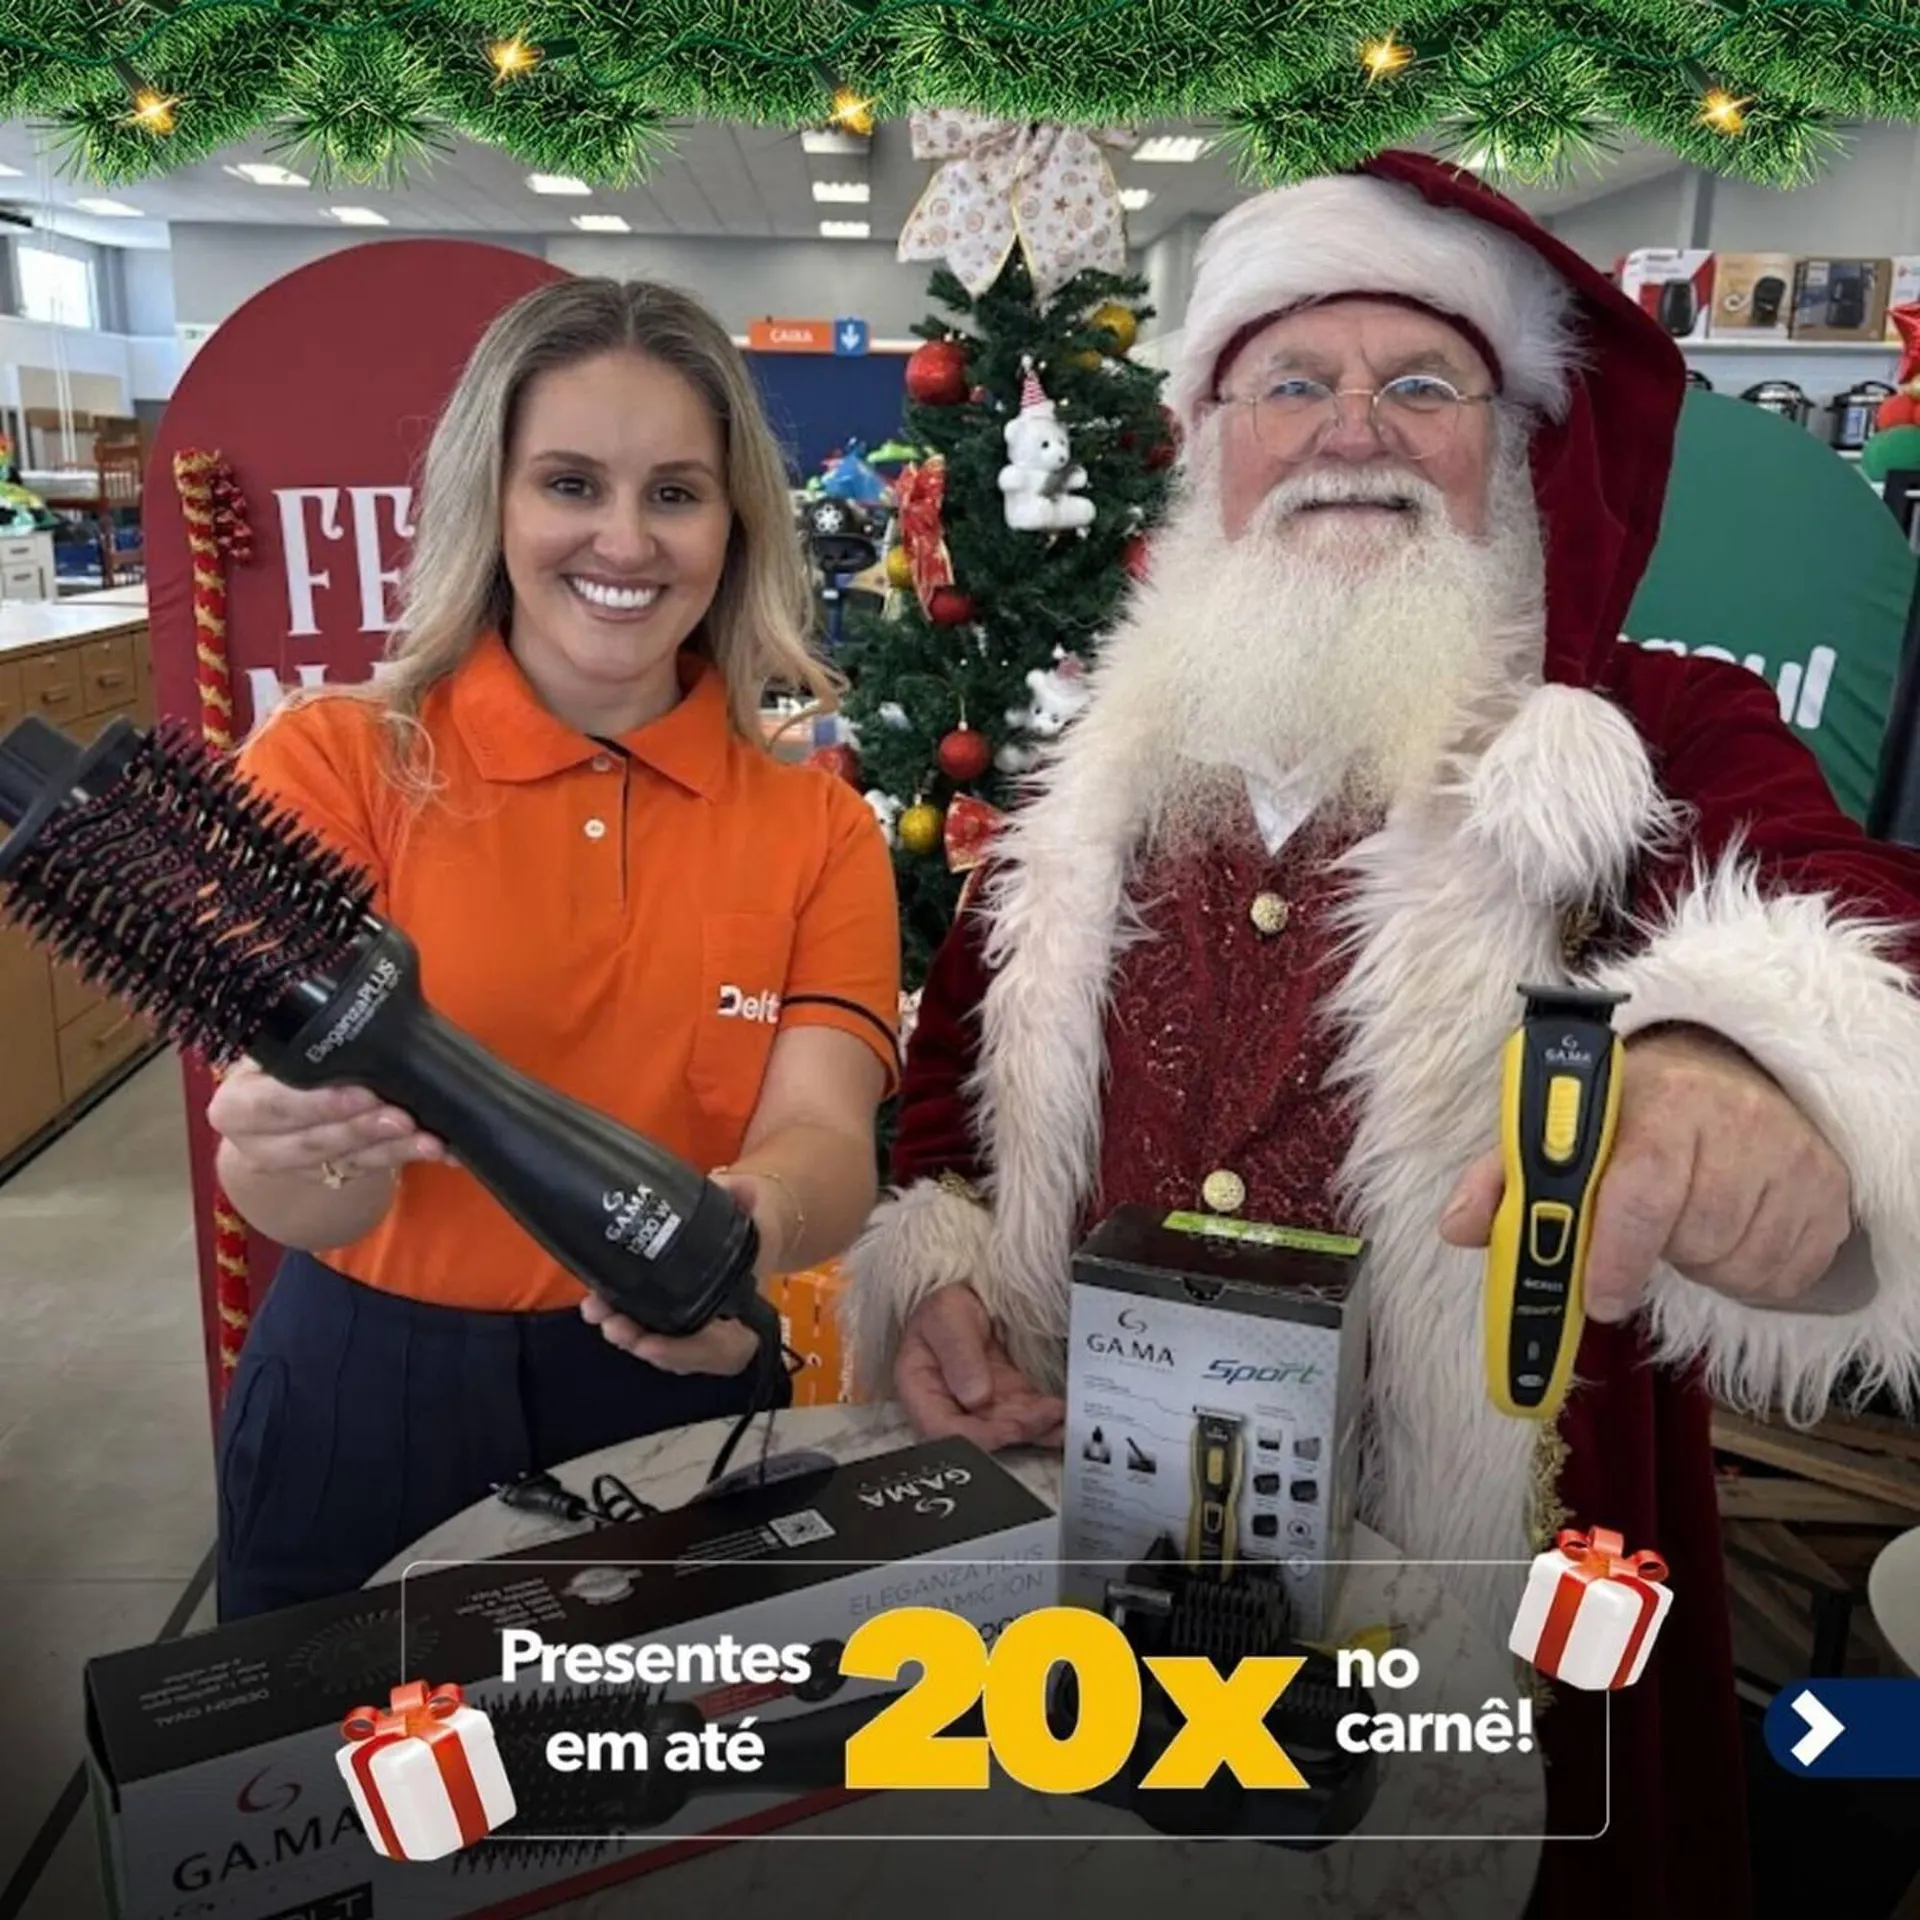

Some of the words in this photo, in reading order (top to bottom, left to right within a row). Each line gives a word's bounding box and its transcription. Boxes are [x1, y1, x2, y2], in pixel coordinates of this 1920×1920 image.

[272, 486, 416, 638] FE
[717, 984, 780, 1024] Delt
[1203, 1358, 1324, 1386] Sport
[851, 1563, 980, 1614] ELEGANZA
